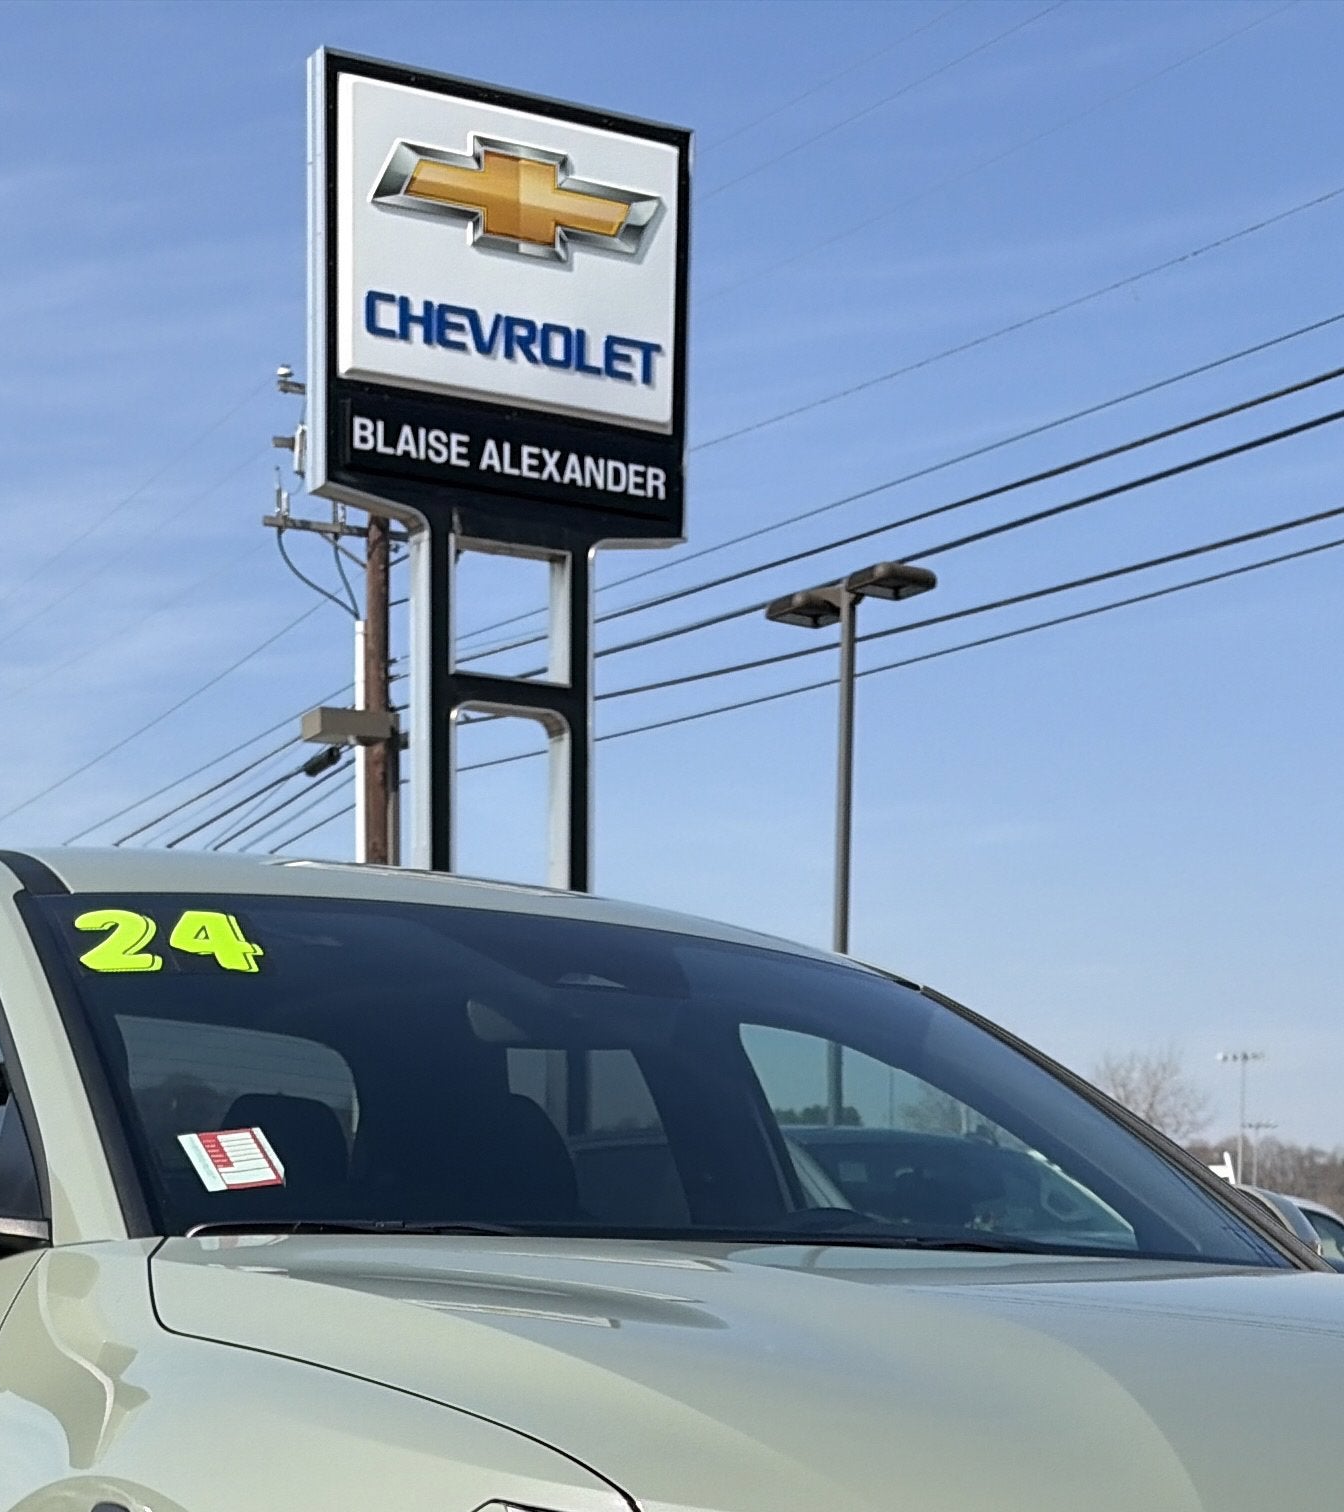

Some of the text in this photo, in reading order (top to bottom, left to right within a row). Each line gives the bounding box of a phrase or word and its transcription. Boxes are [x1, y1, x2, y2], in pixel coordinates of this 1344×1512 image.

[364, 289, 663, 386] CHEVROLET
[351, 415, 668, 501] BLAISE ALEXANDER
[74, 909, 264, 973] 24
